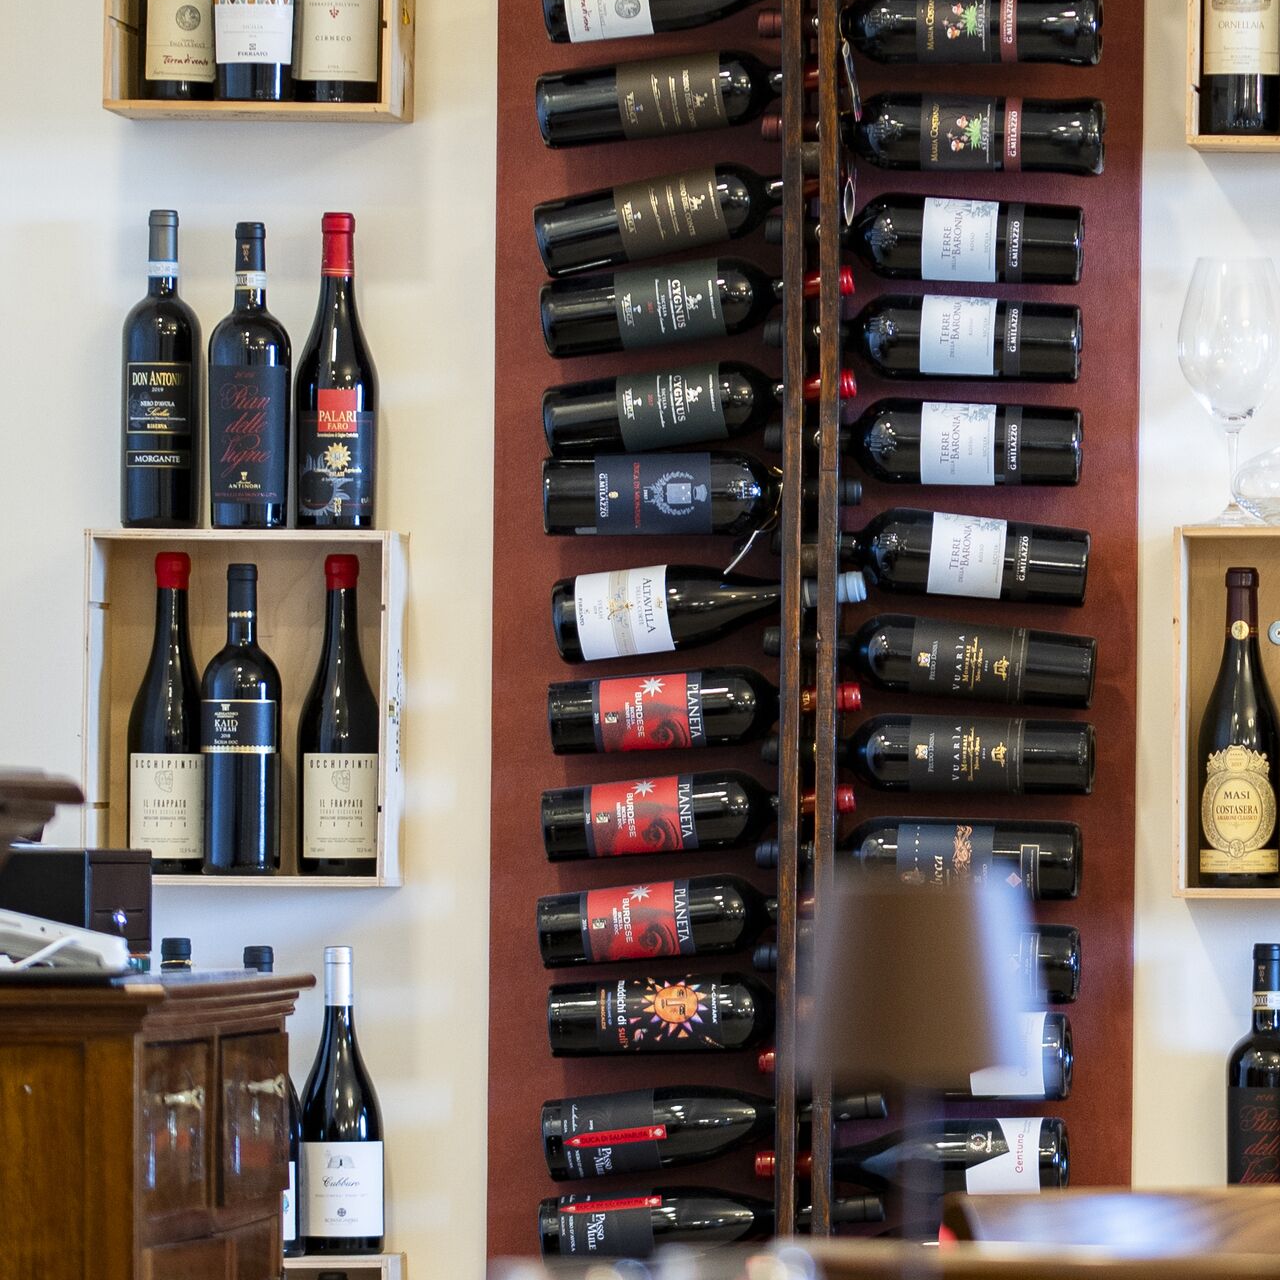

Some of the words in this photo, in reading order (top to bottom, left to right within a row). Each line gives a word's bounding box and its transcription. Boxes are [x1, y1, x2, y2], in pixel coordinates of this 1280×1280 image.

[1218, 20, 1265, 30] ORNELLAIA
[1010, 110, 1018, 157] G.MILAZZO
[941, 226, 951, 260] TERRE
[952, 211, 963, 256] BARONIA
[1011, 220, 1020, 268] G.MILAZZO
[672, 279, 686, 329] CYGNUS
[939, 312, 951, 345] TERRE
[1009, 308, 1019, 353] G.MILAZZO
[132, 371, 148, 386] DON
[672, 374, 687, 422] CYGNUS
[318, 409, 357, 423] PALARI
[327, 422, 349, 431] FARO
[939, 431, 951, 465] TERRE
[950, 415, 962, 461] BARONIA
[1009, 423, 1018, 471] G.MILAZZO
[134, 454, 181, 464] MORGANTE
[598, 472, 607, 518] G.MILAZZO
[949, 536, 961, 571] TERRE
[960, 524, 973, 567] BARONIA
[1018, 535, 1029, 582] G.MILAZZO
[643, 577, 657, 634] ALTAVILLA
[214, 719, 239, 728] KAID
[634, 691, 646, 738] BURDESE
[686, 683, 703, 739] PLANETA
[136, 759, 198, 769] OCCHIPINTI
[310, 759, 374, 769] OCCHIPINTI
[153, 799, 187, 808] FRAPPATO
[330, 799, 363, 808] FRAPPATO
[678, 783, 693, 838] PLANETA
[1215, 804, 1259, 815] COSTASERA
[1223, 789, 1250, 800] MASI
[626, 792, 637, 838] BURDESE
[622, 897, 633, 943] BURDESE
[674, 887, 690, 944] PLANETA
[617, 1015, 626, 1025] di
[601, 1146, 613, 1170] PASSO
[1015, 1133, 1025, 1174] Centuno
[587, 1221, 598, 1251] MULE
[594, 1212, 607, 1241] PASSO
